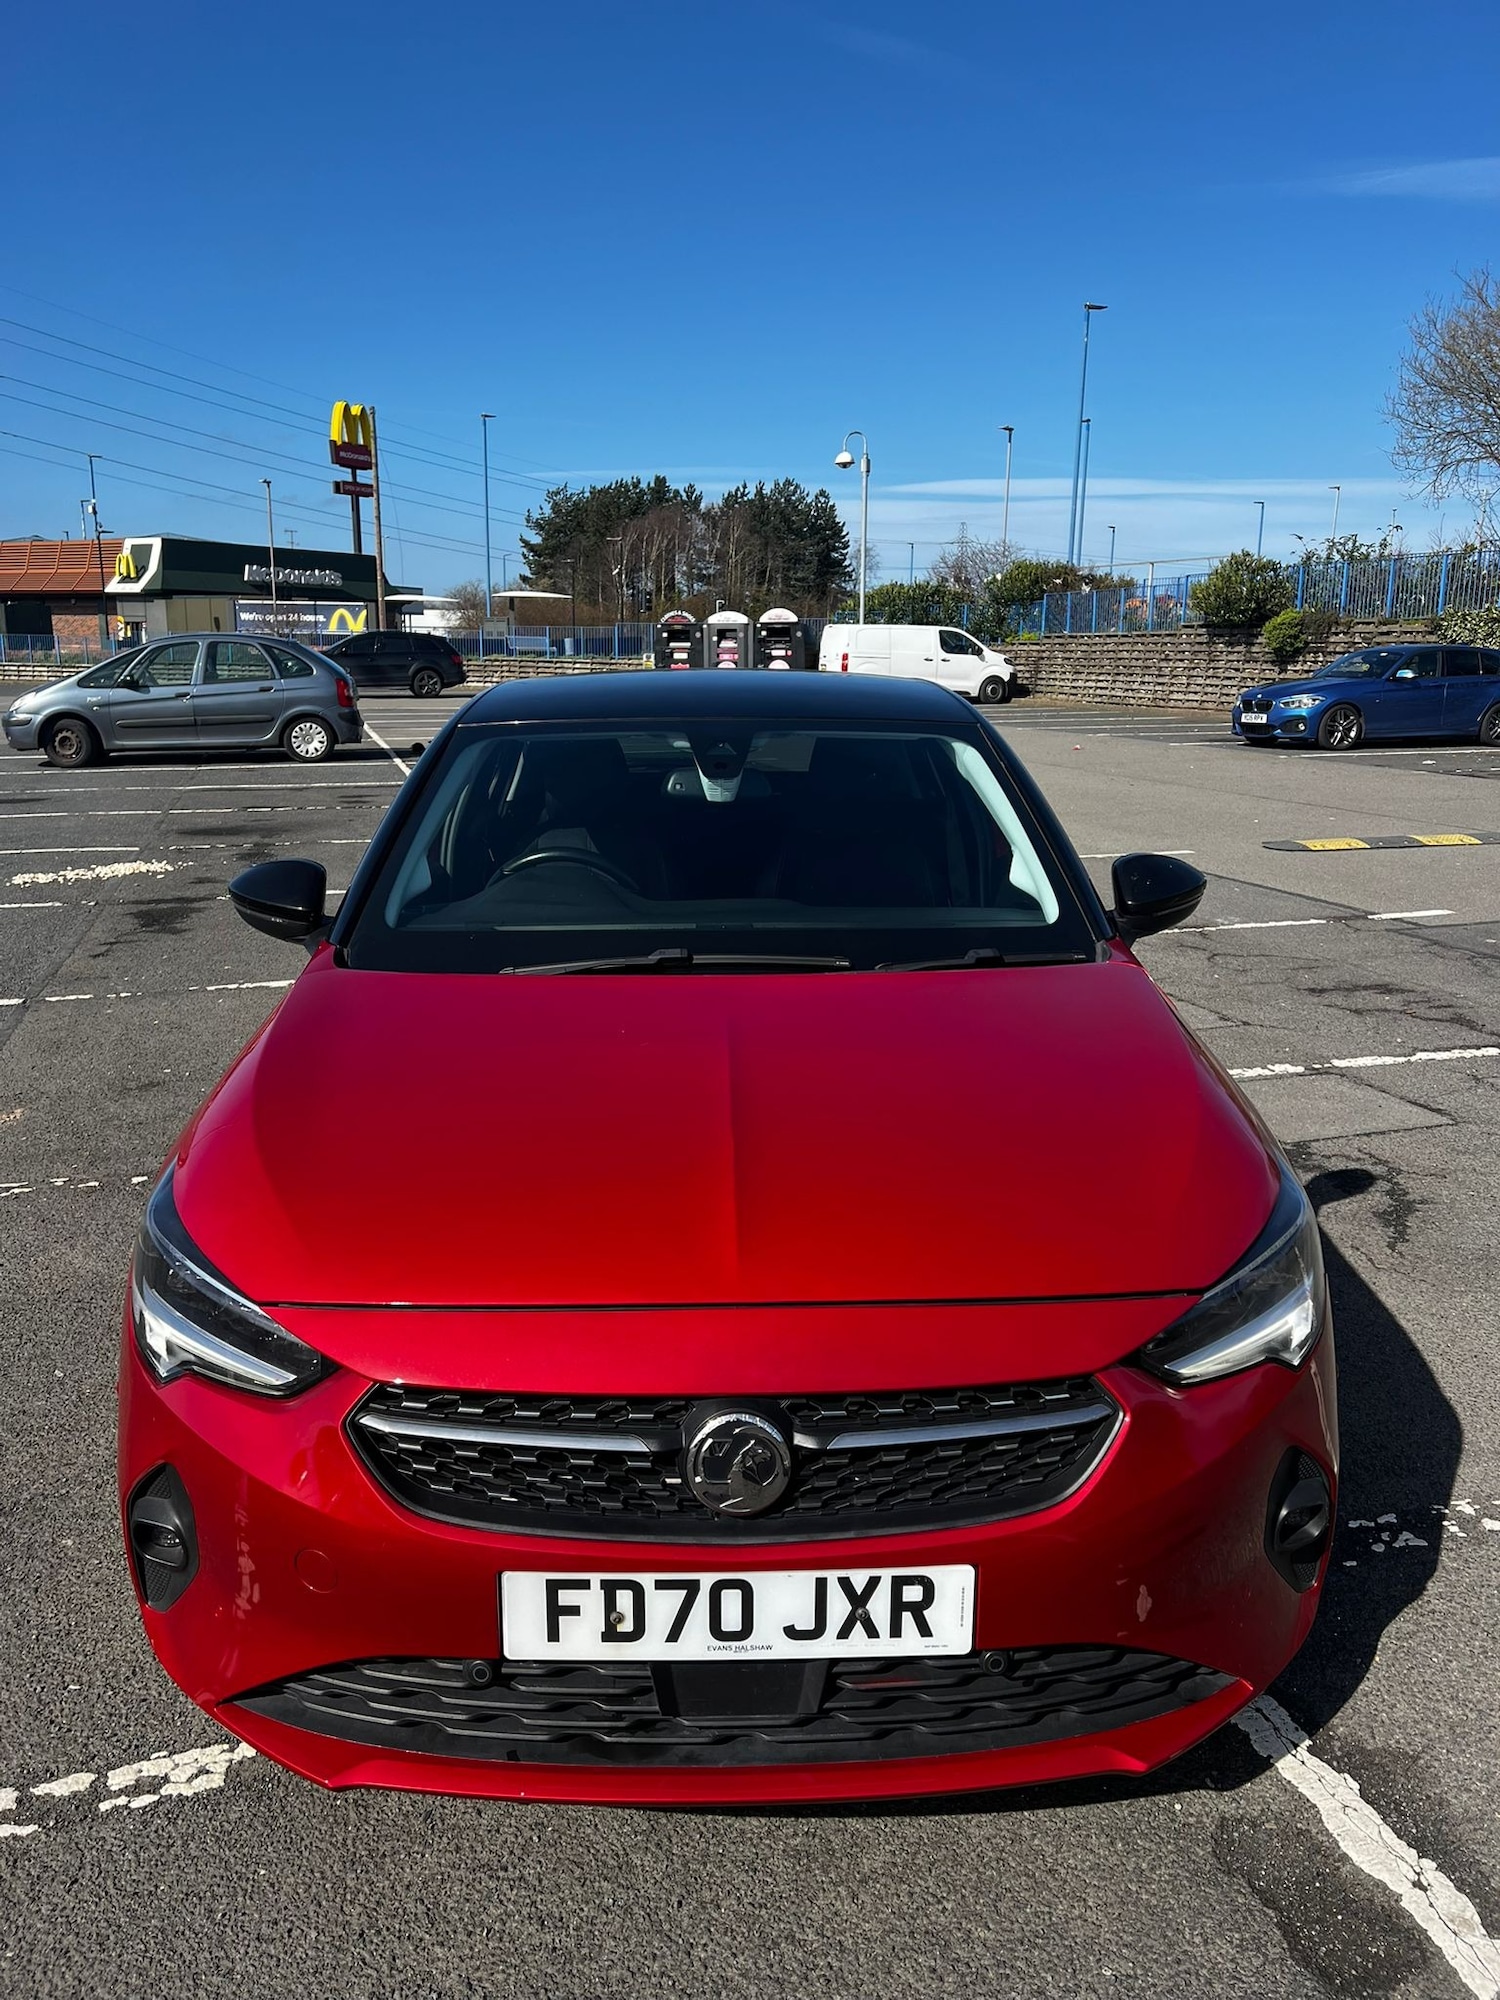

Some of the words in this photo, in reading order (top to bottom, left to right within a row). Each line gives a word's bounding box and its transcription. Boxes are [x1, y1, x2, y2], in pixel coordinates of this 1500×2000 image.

[243, 564, 342, 586] McDonald's
[288, 613, 298, 621] 24
[545, 1579, 754, 1643] FD70
[782, 1575, 935, 1641] JXR
